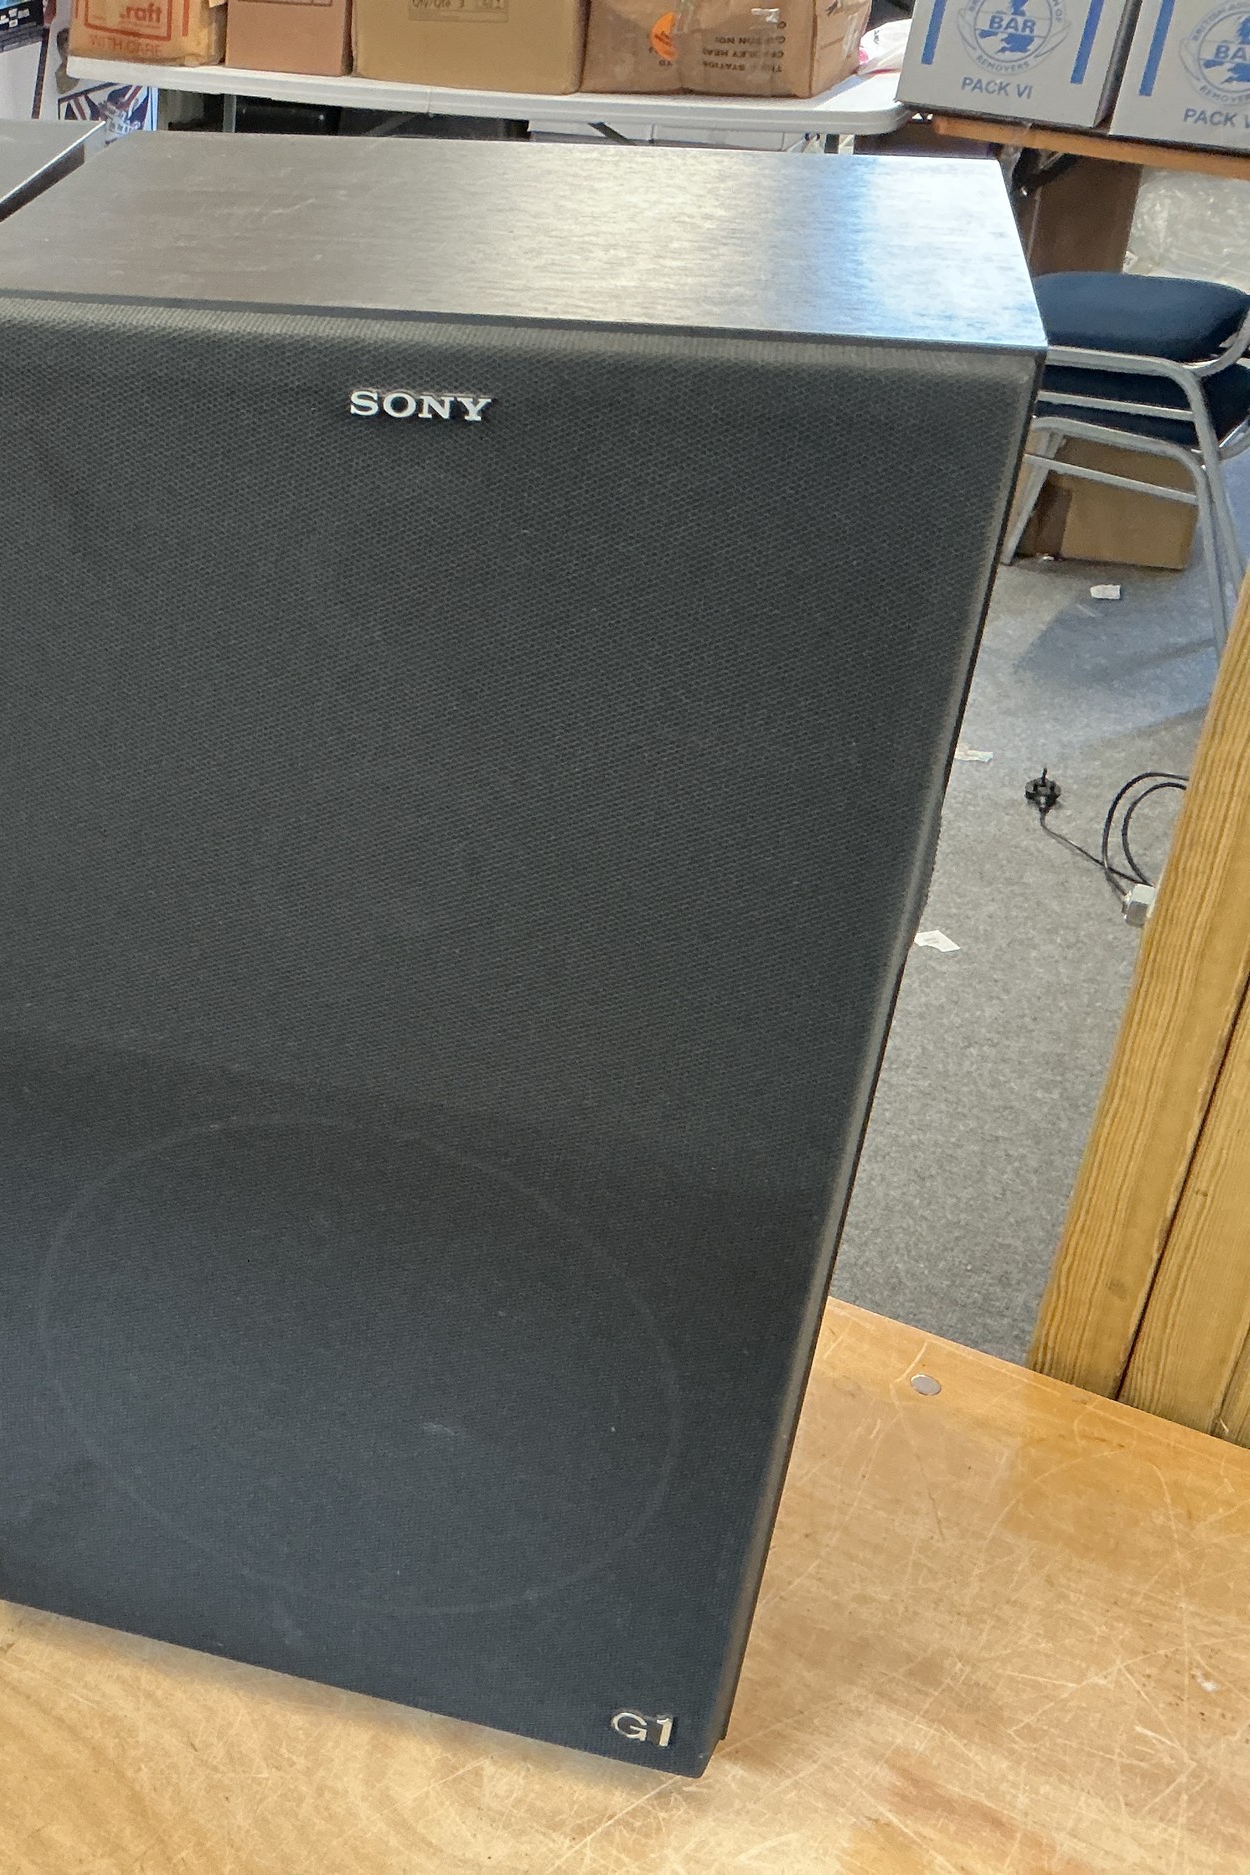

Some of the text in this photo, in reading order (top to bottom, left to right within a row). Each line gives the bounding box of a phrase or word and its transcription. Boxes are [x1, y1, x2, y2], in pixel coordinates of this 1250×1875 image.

[988, 15, 1037, 33] BAR
[1214, 45, 1250, 61] BA
[975, 54, 1031, 73] REMOVERS
[961, 77, 1033, 99] PACK VI
[1199, 84, 1250, 102] REMOVER
[1183, 108, 1238, 127] PACK
[350, 388, 492, 421] SONY
[612, 1711, 672, 1748] G1
